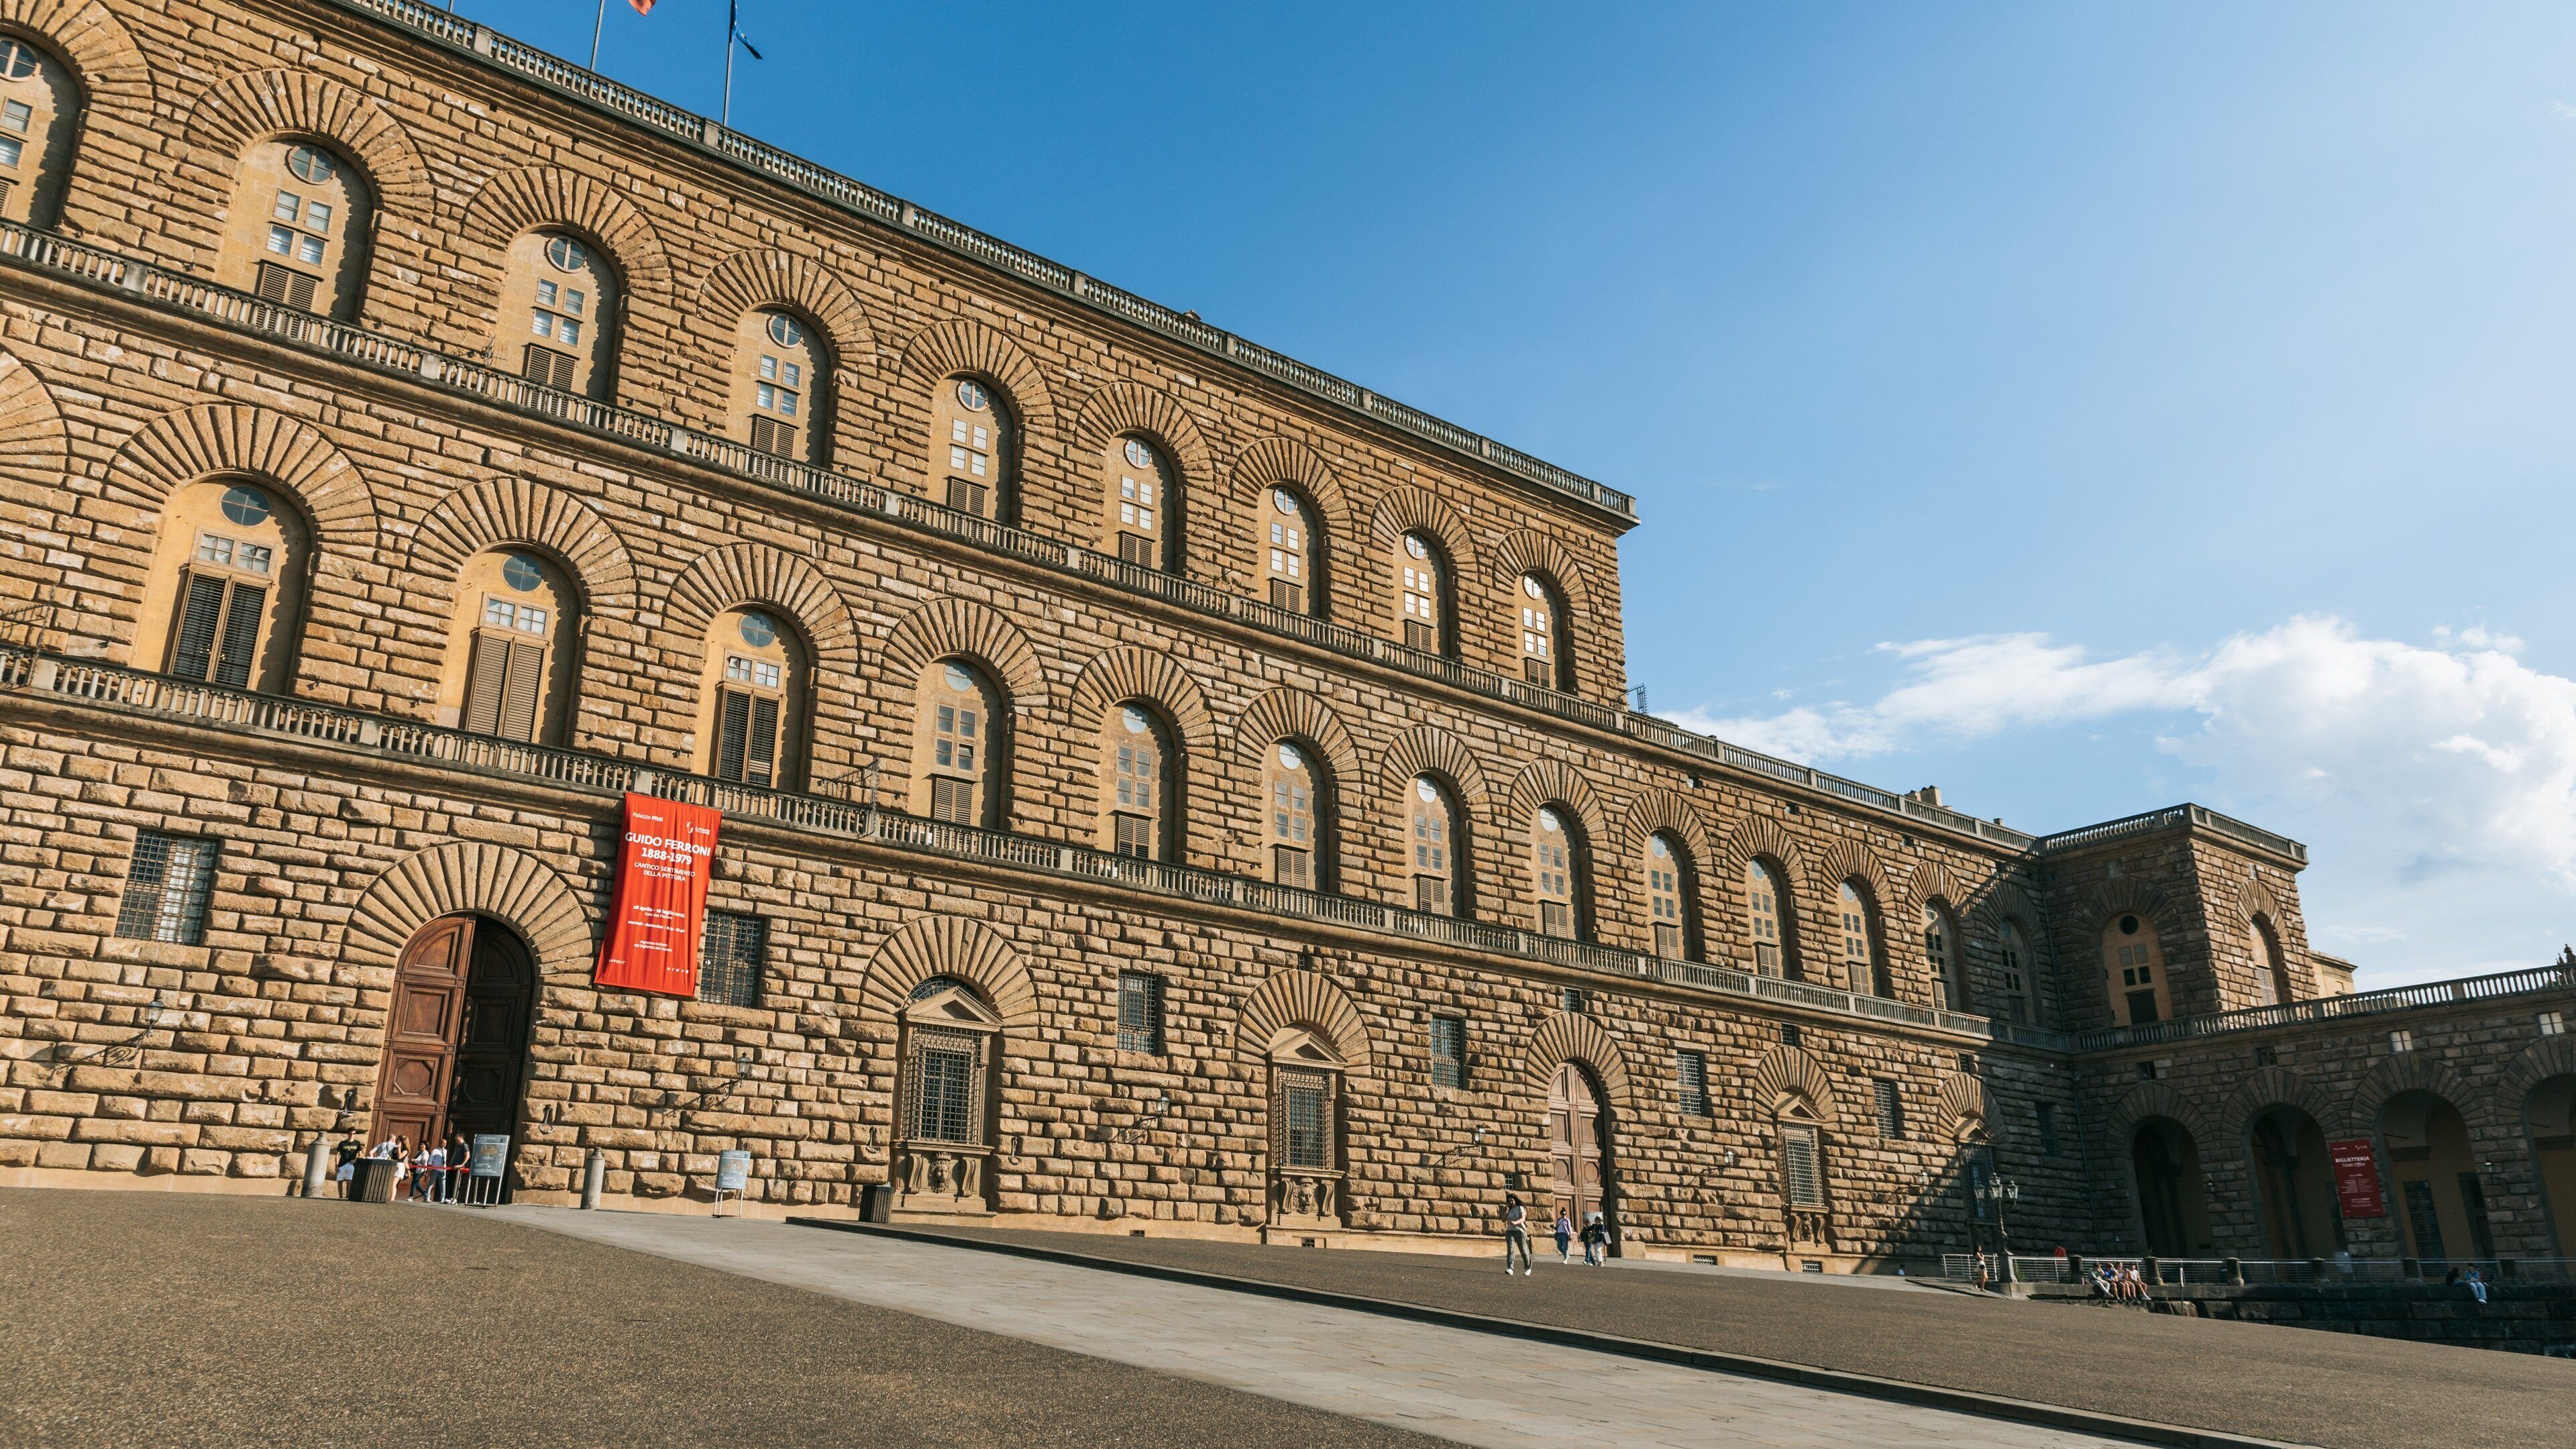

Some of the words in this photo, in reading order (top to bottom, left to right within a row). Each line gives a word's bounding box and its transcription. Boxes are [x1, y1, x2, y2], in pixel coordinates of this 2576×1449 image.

[625, 832, 662, 847] GUIDO
[665, 839, 710, 856] FERRONI
[641, 847, 692, 865] 1888-1979
[635, 862, 659, 870] L'ANTICO
[661, 866, 695, 877] SENTIMENTO
[662, 873, 686, 881] PITTURA
